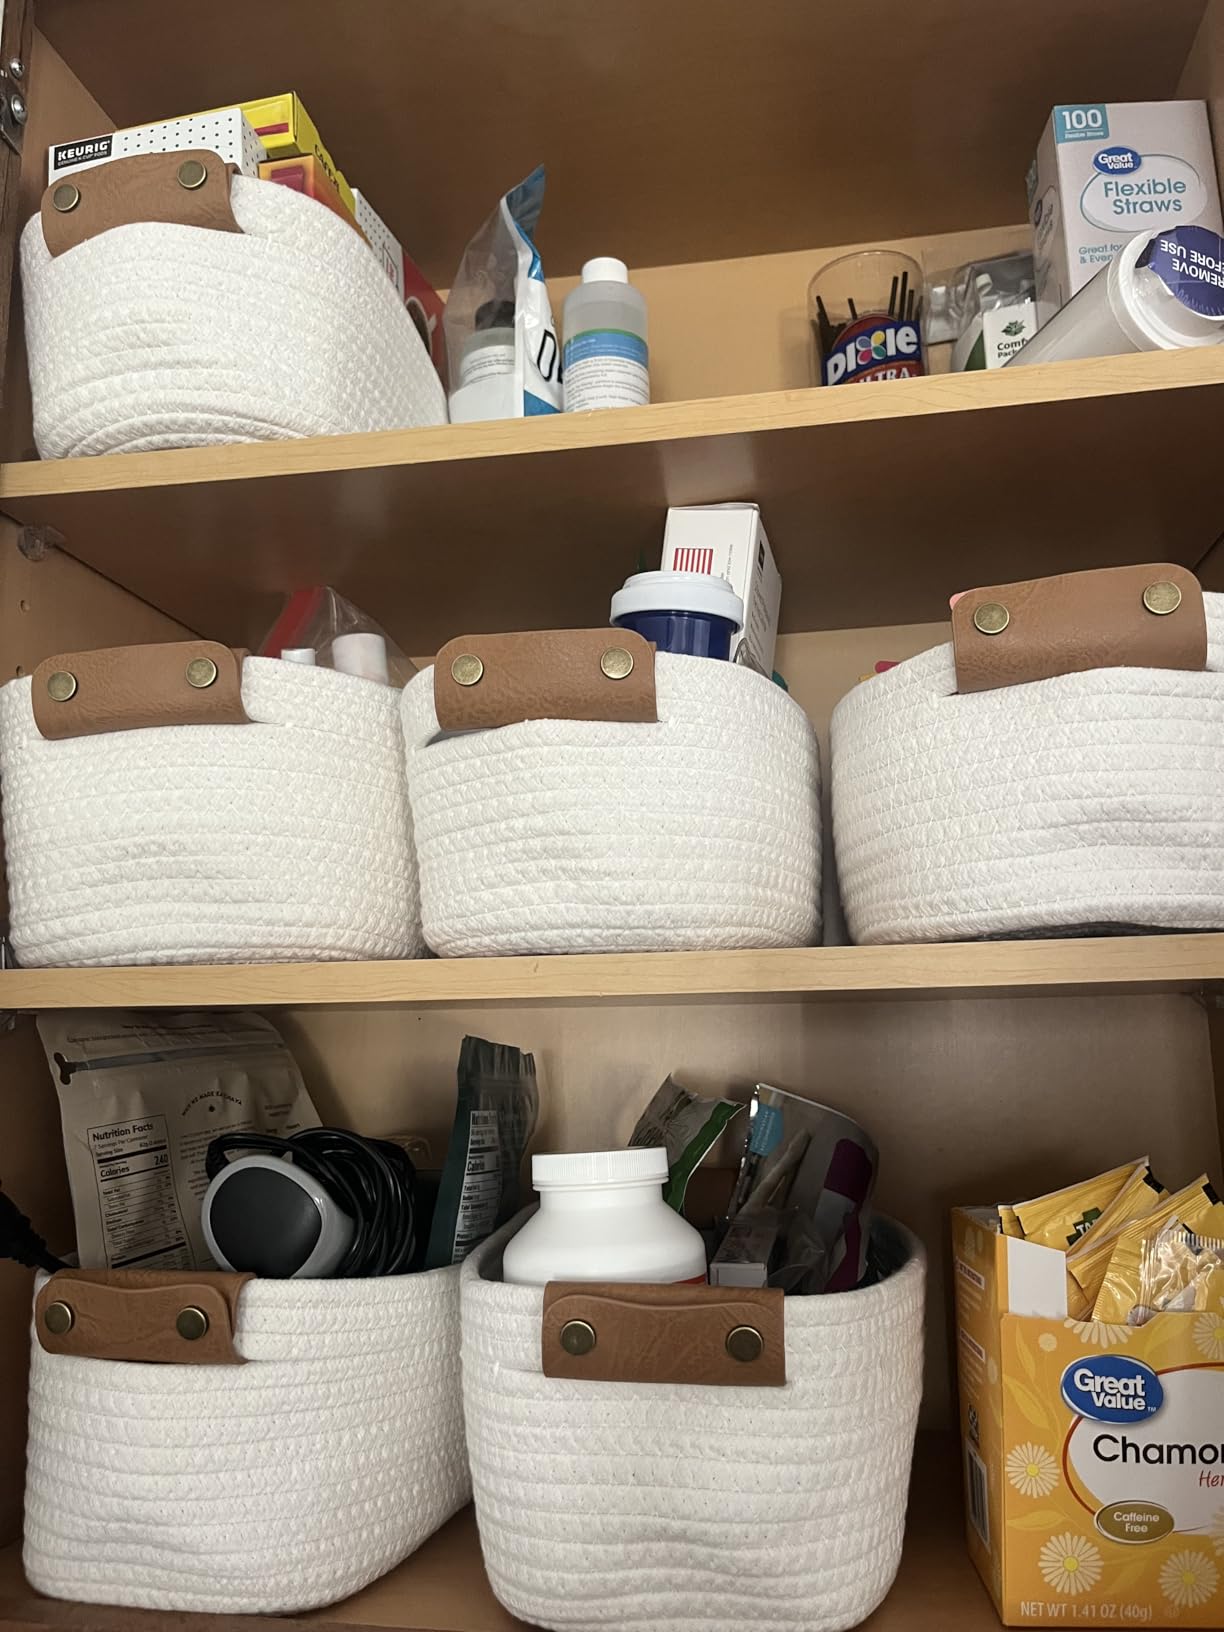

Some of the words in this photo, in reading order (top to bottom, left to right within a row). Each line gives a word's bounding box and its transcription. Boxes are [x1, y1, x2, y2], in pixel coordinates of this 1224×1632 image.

[1062, 109, 1102, 130] 100
[58, 141, 107, 161] KEURIG
[1098, 152, 1133, 164] Great
[1107, 161, 1134, 170] Value
[1104, 178, 1187, 198] Flexible
[1112, 198, 1183, 216] Straws
[1079, 245, 1107, 255] Great
[1160, 239, 1187, 259] USE
[1172, 258, 1224, 289] REMOVE
[92, 1128, 131, 1142] Nutrition
[132, 1123, 153, 1134] Facts
[101, 1166, 130, 1177] Calories
[154, 1154, 168, 1165] 240
[1073, 1367, 1146, 1397] Great
[1092, 1391, 1146, 1411] Value
[1093, 1434, 1224, 1465] Chamo
[1113, 1511, 1160, 1522] Caffeine
[1125, 1523, 1148, 1533] Free
[1020, 1602, 1044, 1617] NET
[1047, 1603, 1067, 1617] WT
[1071, 1604, 1096, 1618] 1.41
[1100, 1604, 1117, 1618] OZ
[1120, 1604, 1152, 1622] (40g)
